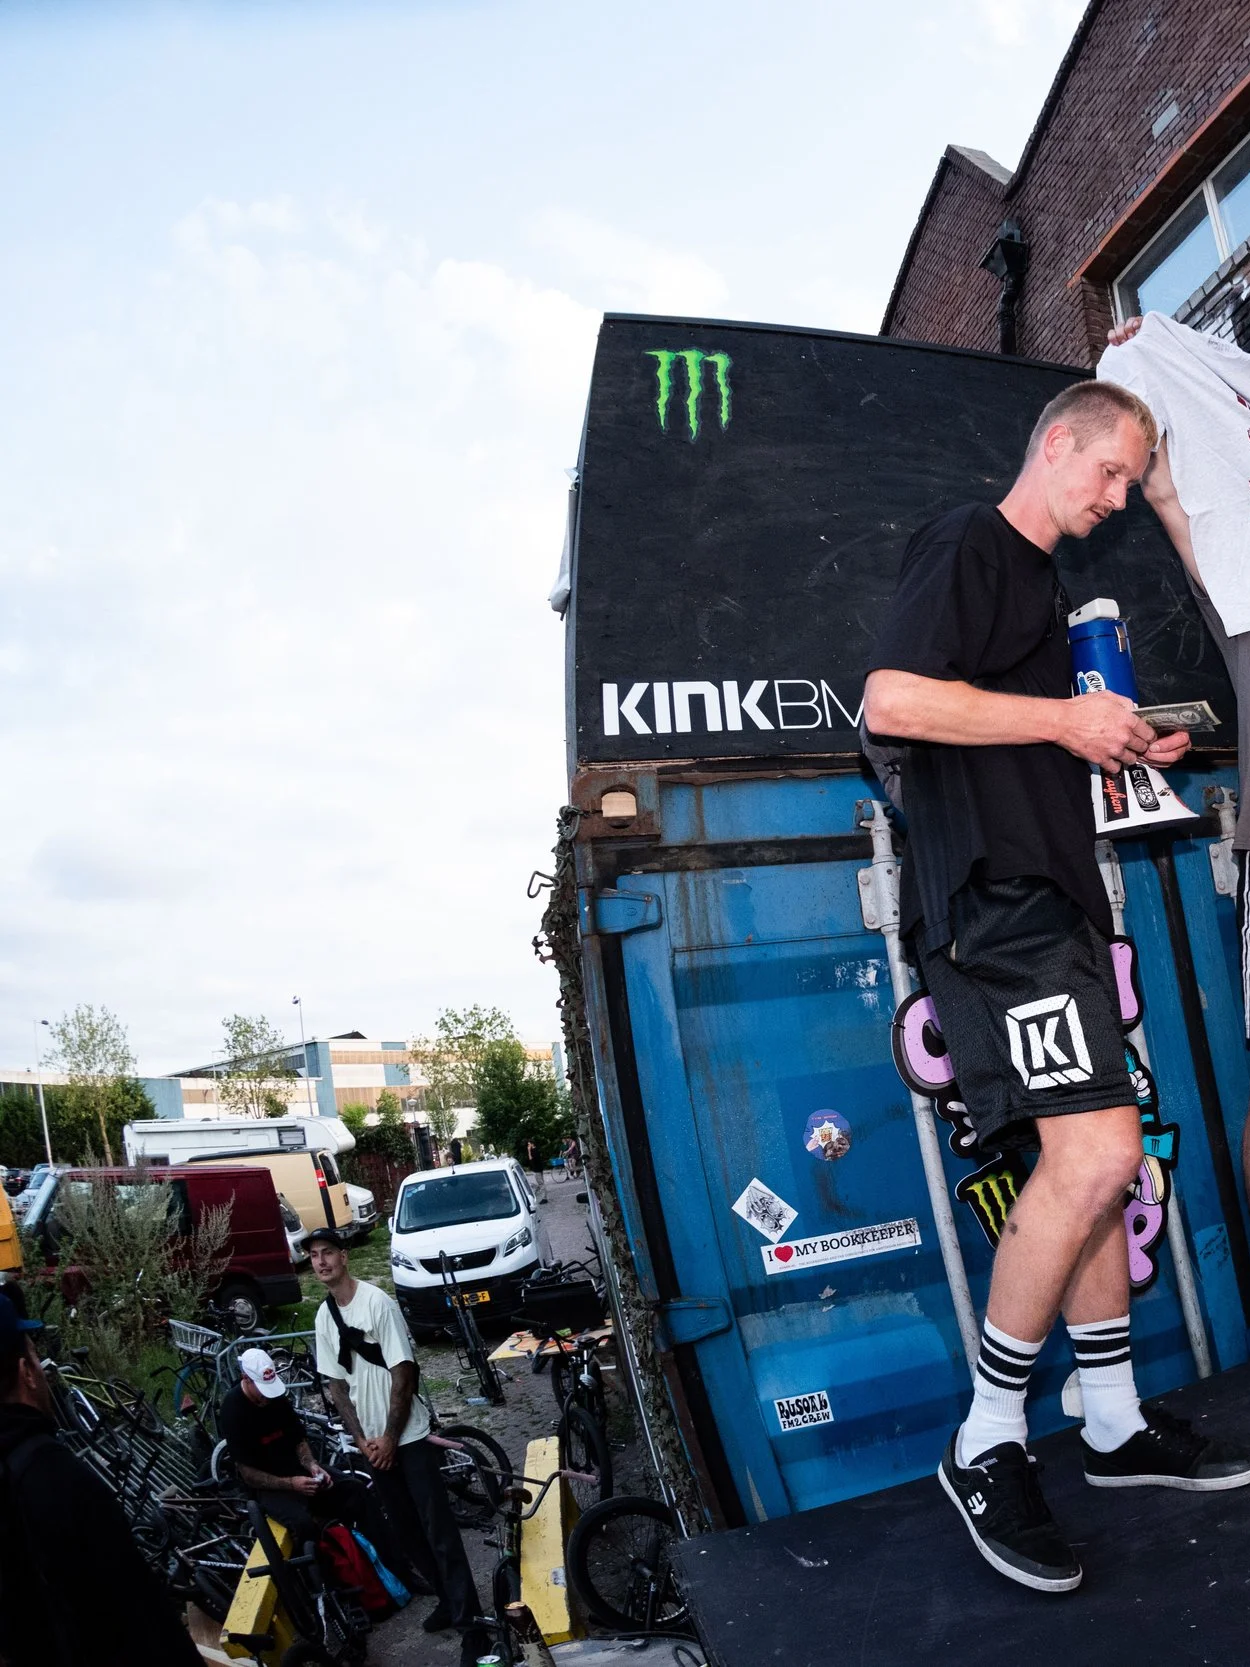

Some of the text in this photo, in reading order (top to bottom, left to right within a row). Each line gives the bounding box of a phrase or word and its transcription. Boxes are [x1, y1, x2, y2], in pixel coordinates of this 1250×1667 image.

[602, 679, 864, 736] KINKBM
[1104, 777, 1126, 814] ayhem
[767, 1250, 774, 1262] I
[794, 1242, 818, 1257] MY
[820, 1223, 915, 1252] BOOKKEEPER
